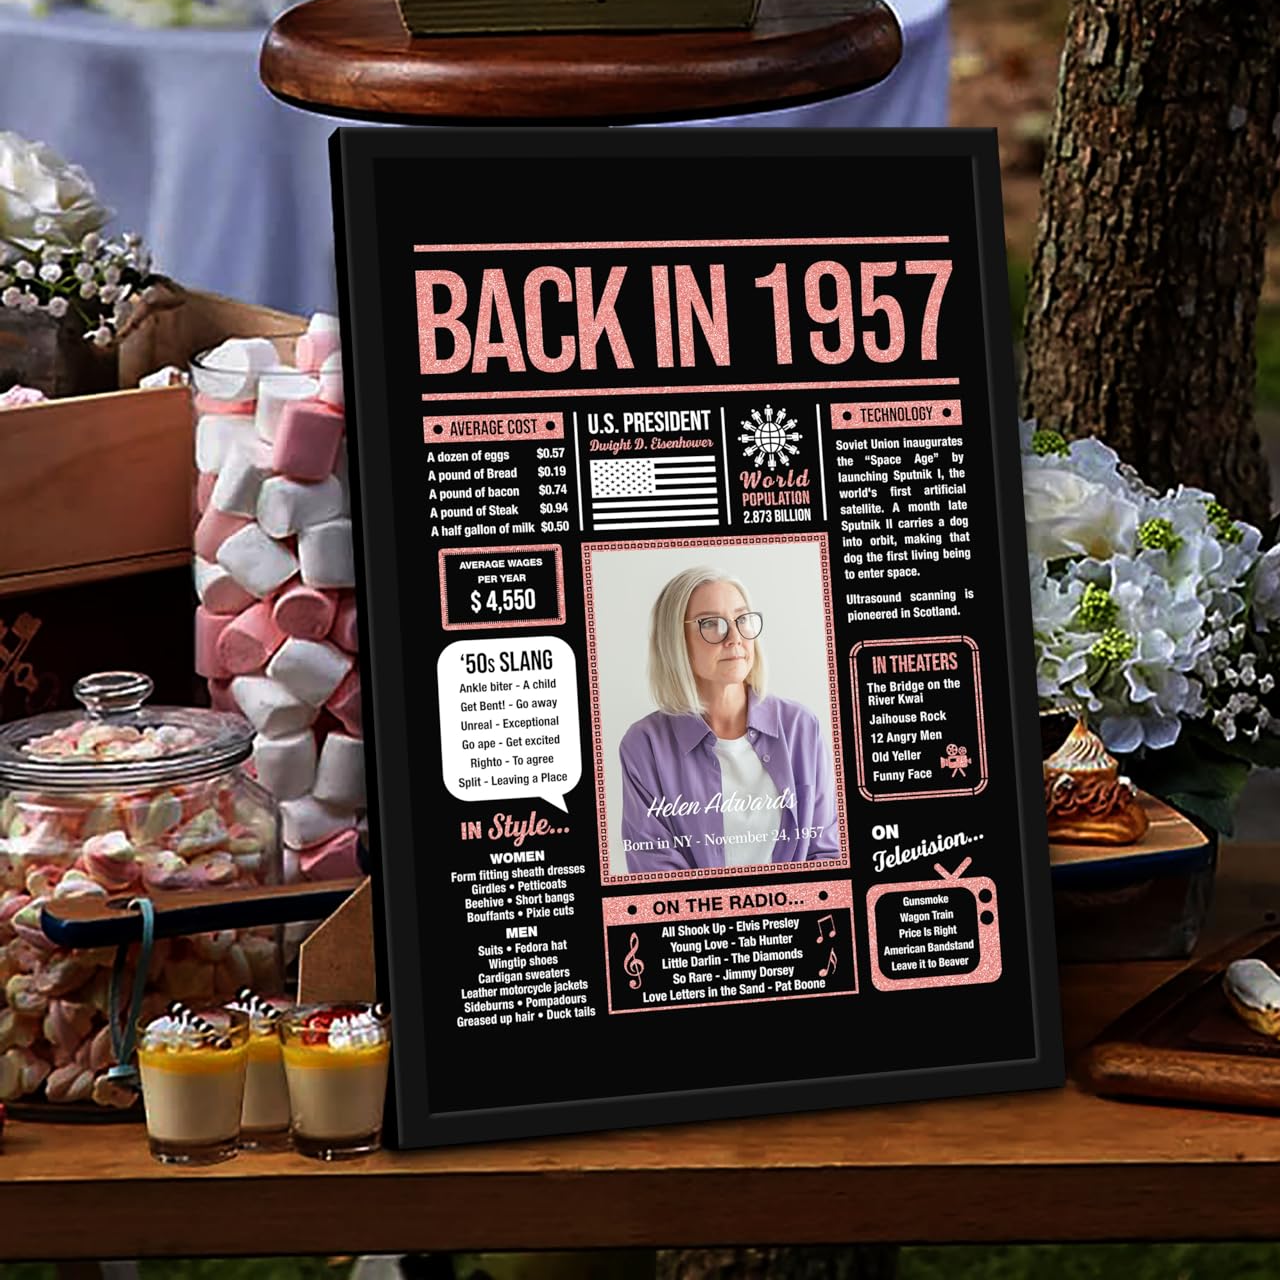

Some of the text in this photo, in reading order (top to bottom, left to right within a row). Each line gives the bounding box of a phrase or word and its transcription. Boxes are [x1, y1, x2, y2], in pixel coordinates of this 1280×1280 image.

[415, 259, 954, 376] BACK IN 1957
[587, 409, 711, 434] U.S. PRESIDENT
[860, 406, 932, 422] TECHNOLOGY
[450, 419, 537, 436] AVERAGE COST
[589, 436, 714, 455] Dwight D. Eisenhower
[835, 436, 963, 451] Soviet Union inaugurates
[426, 447, 565, 462] A dozen of eggs $0.57
[428, 465, 566, 483] A pound of Bread $0.19
[739, 468, 810, 489] World
[742, 490, 810, 507] POPULATION
[839, 483, 966, 499] world's first artificial
[840, 499, 967, 515] satellite. A month late
[743, 508, 811, 524] 2.873 BILLION
[430, 520, 569, 538] A half gallon of milk $0.50
[459, 558, 543, 569] AVERAGE WAGES
[477, 573, 526, 584] PER YEAR
[846, 588, 974, 605] Ultrasound scanning is
[847, 605, 960, 623] pioneered in Scotland.
[499, 649, 553, 672] SLANG
[872, 651, 958, 674] IN THEATERS
[459, 678, 556, 693] Ankle biter A child
[866, 678, 960, 693] The Bridge on the
[868, 693, 924, 706] River Kwai
[461, 715, 559, 731] Unreal Exceptional
[919, 710, 947, 722] Rock
[871, 750, 921, 763] Old Yeller
[873, 768, 932, 782] Funny Face
[646, 793, 702, 818] Helen
[460, 821, 482, 840] IN
[871, 823, 899, 840] ON
[623, 827, 825, 852] Born in NY November 24, 1957
[489, 850, 545, 864] WOMEN
[451, 865, 585, 883] Form fitting sheath dresses
[471, 878, 567, 895] Girdles Petticoats
[652, 899, 679, 915] ON
[685, 896, 723, 912] THE
[902, 894, 949, 906] Gunsmoke
[467, 905, 574, 923] Bouffants Pixie cuts
[899, 909, 954, 923] Wagon Train
[505, 925, 538, 939] MEN
[661, 918, 799, 938] All Shook Up Elvis Presley
[899, 925, 957, 938] Price Is Right
[670, 934, 793, 953] Young Love Tab Hunter
[883, 939, 974, 956] American Bandstand
[488, 955, 558, 970] Wingtip shoes
[662, 948, 803, 969] Little Darlin The Diamonds
[478, 968, 570, 984] Cardigan sweaters
[461, 979, 588, 999] Leather motorcycle jackets
[464, 994, 587, 1013] Sideburns Pompadours
